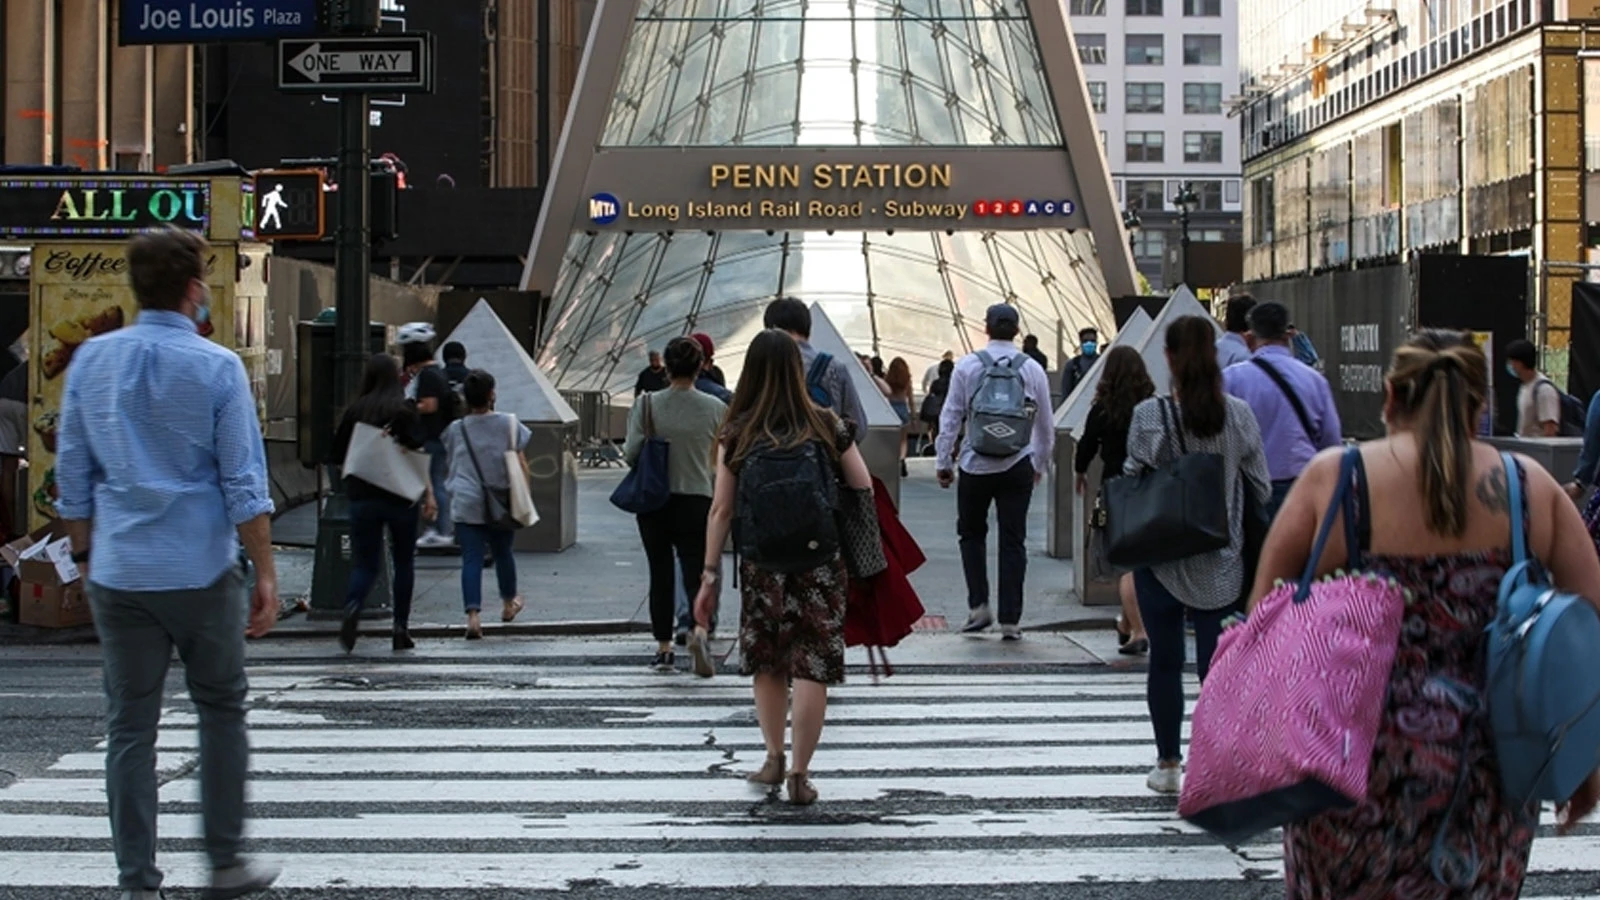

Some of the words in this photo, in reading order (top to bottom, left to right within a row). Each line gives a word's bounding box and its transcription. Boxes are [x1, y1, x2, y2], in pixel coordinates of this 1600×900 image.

[139, 4, 182, 30] Joe
[190, 1, 255, 29] Louis
[263, 9, 301, 25] Plaza
[303, 54, 340, 71] ONE
[359, 54, 401, 71] WAY
[711, 164, 800, 188] PENN
[813, 164, 951, 188] STATION
[50, 189, 138, 221] ALL
[589, 198, 617, 219] MTA
[627, 202, 680, 221] Long
[688, 201, 751, 217] Island
[760, 201, 800, 217] Rail
[808, 201, 863, 217] Road
[884, 200, 968, 220] Subway
[44, 250, 126, 278] Coffee
